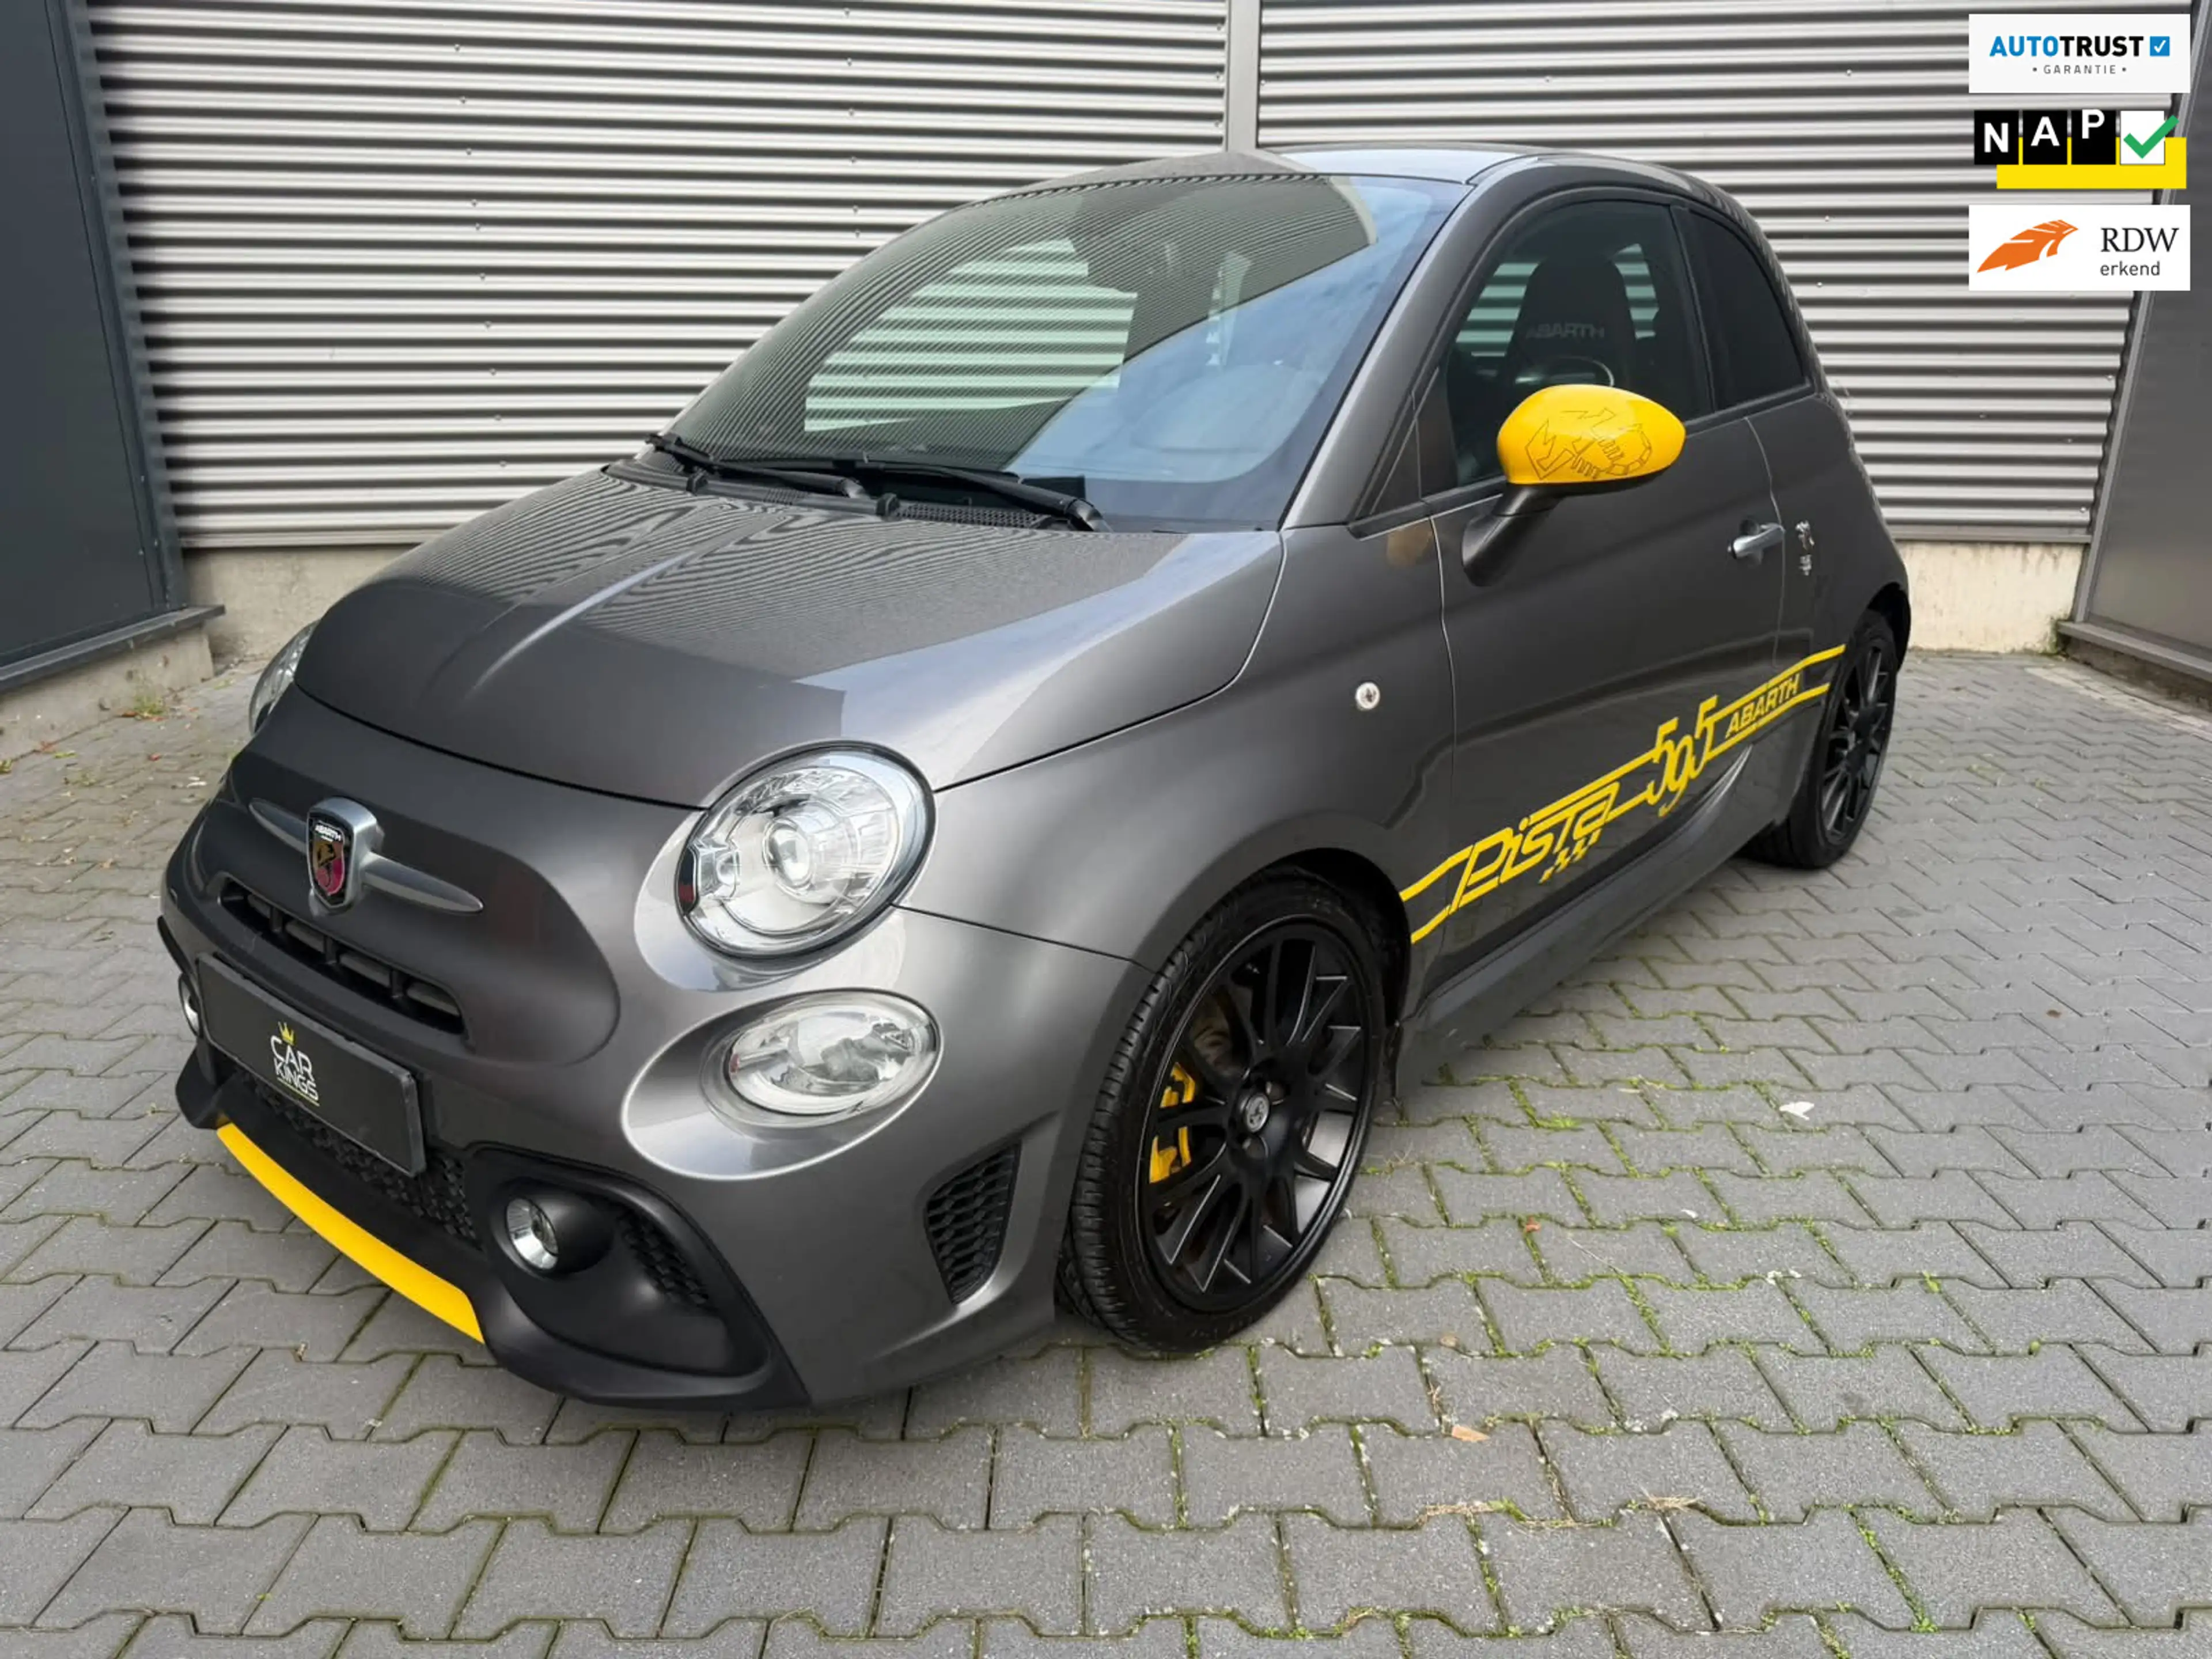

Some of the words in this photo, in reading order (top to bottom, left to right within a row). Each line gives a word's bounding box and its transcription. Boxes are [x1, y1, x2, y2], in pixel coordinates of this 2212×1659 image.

[1647, 694, 1718, 816] 595
[1725, 673, 1800, 738] ABARTH
[271, 1035, 315, 1082] CAR
[274, 1058, 319, 1101] KINGS
